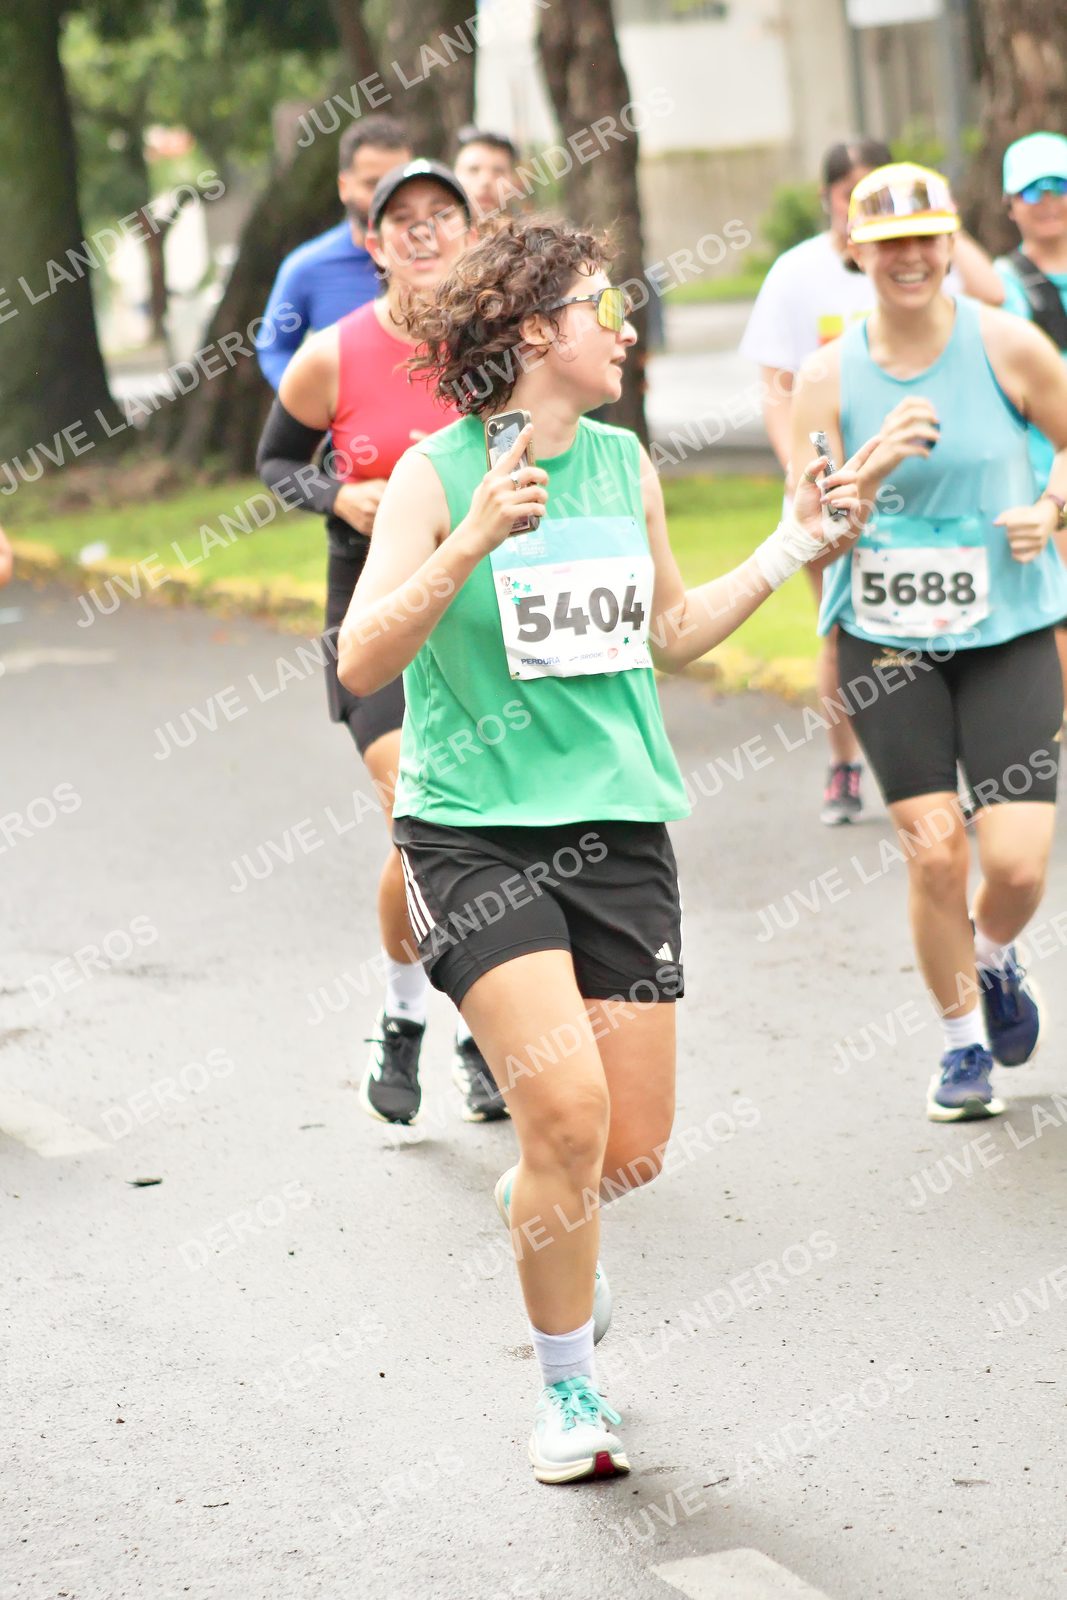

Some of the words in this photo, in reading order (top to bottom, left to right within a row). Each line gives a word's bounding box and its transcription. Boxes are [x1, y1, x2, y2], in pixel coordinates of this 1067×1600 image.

[861, 571, 977, 606] 5688
[515, 585, 645, 643] 5404
[520, 655, 561, 665] PERDURA
